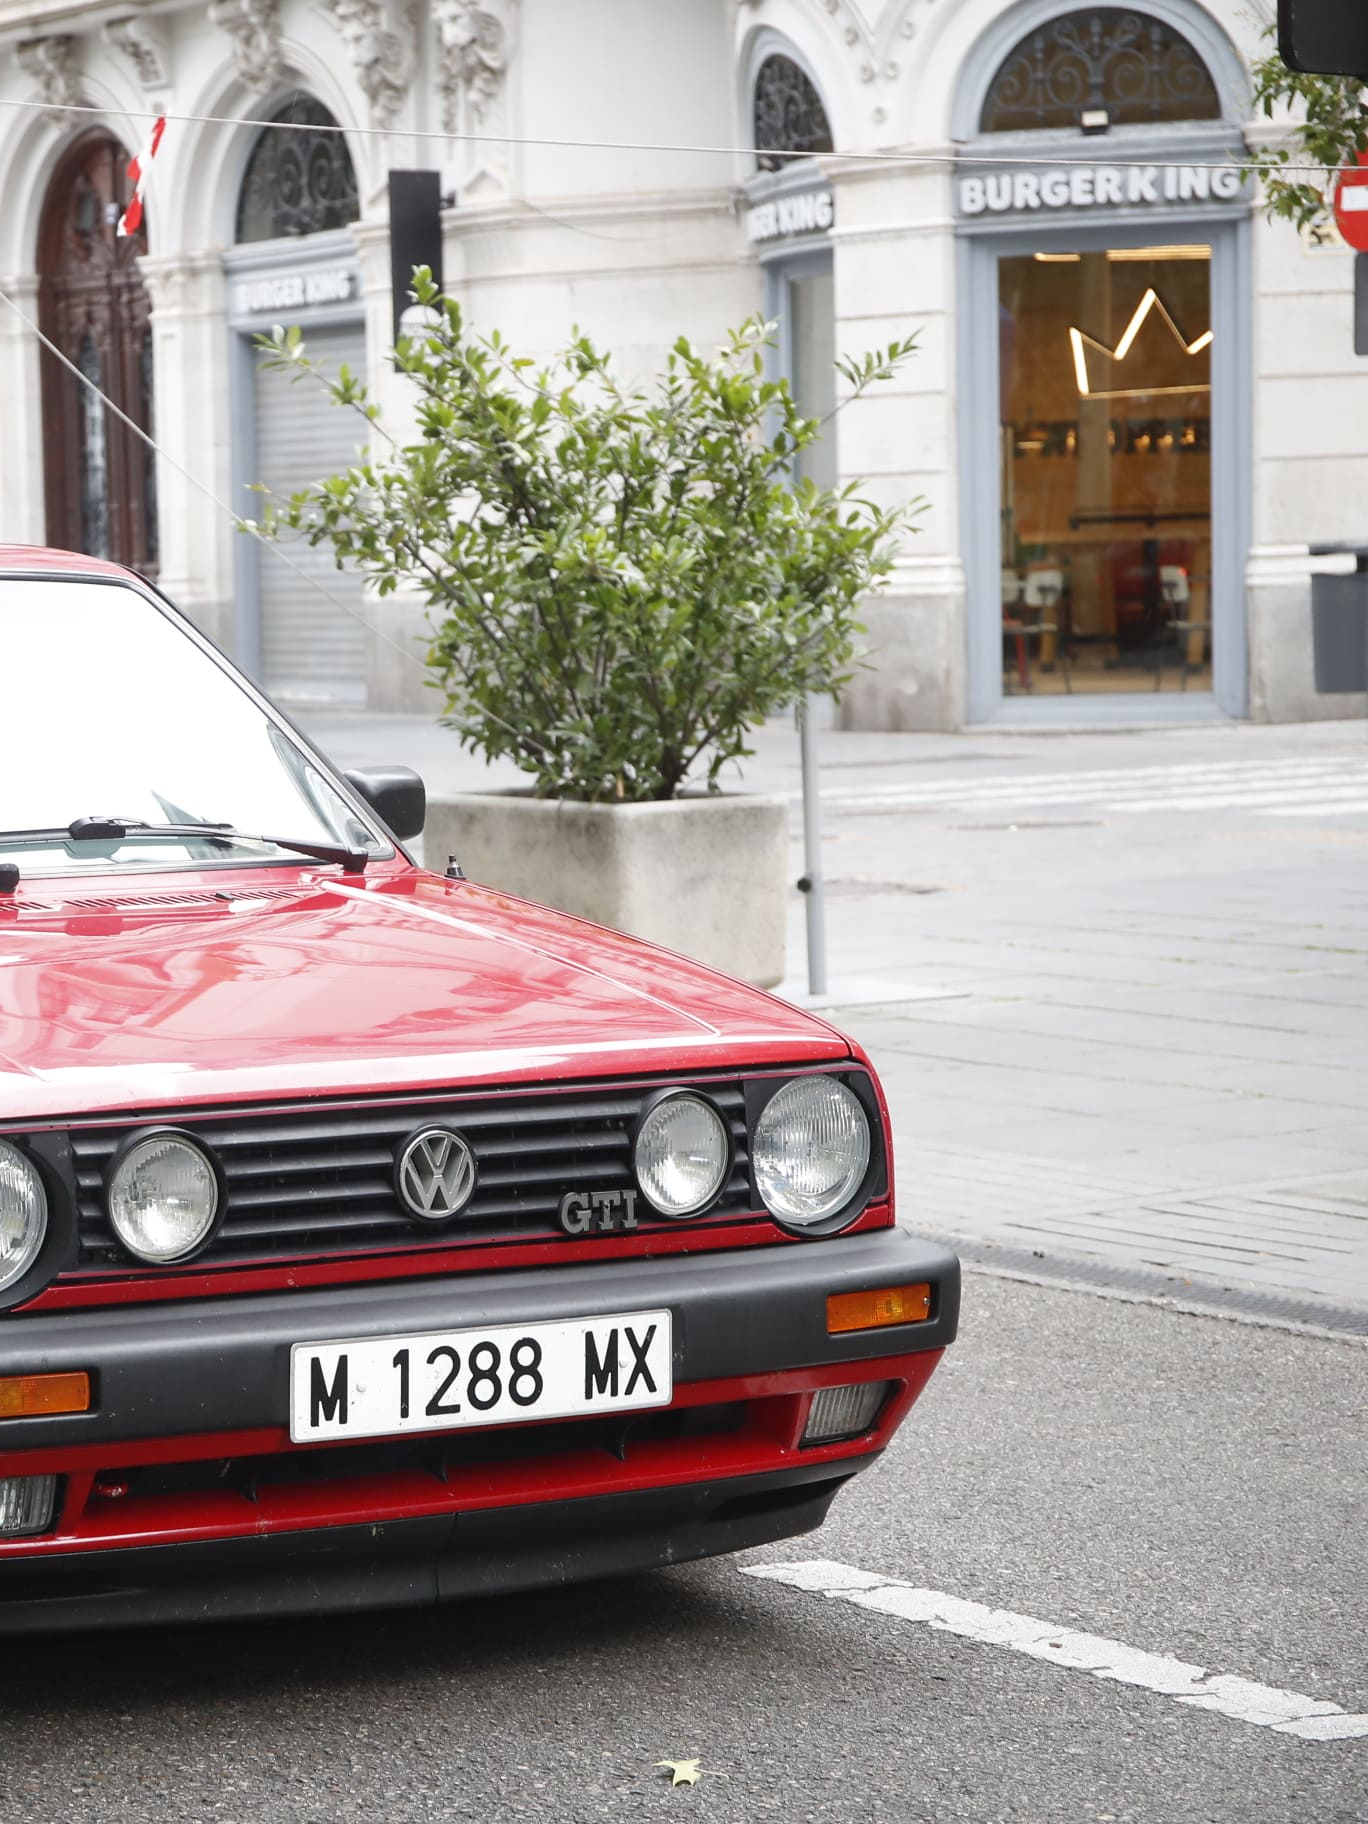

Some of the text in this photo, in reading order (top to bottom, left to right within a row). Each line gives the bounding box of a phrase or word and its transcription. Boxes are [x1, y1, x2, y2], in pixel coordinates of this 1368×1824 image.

[778, 192, 832, 233] KING
[959, 163, 1240, 214] BURGER KING
[560, 1189, 638, 1234] GTI
[310, 1324, 657, 1427] M 1288 MX
